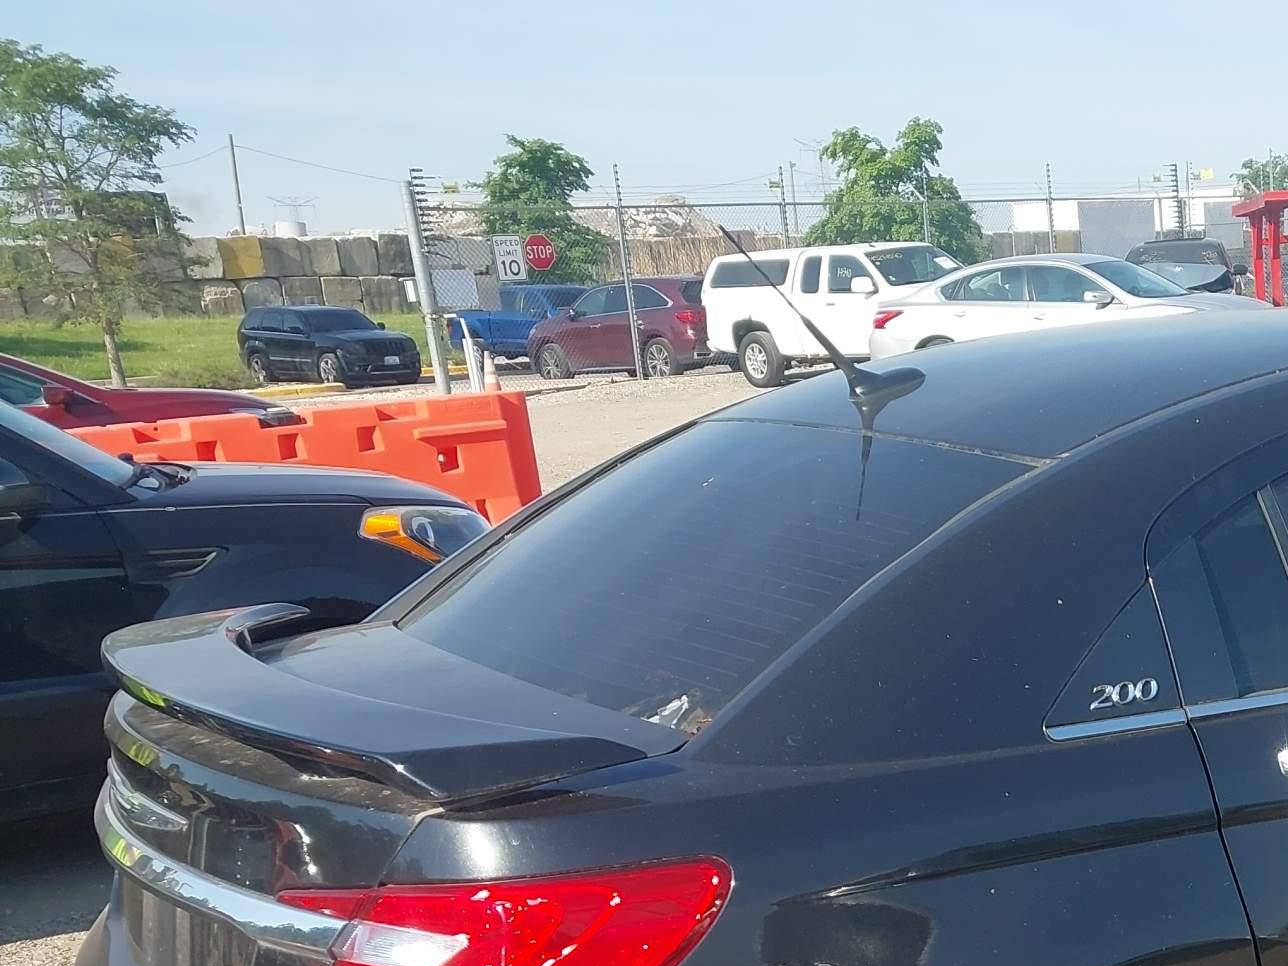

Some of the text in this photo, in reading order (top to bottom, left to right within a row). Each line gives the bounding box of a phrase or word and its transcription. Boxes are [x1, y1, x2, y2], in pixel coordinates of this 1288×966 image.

[526, 245, 552, 259] STOP
[501, 260, 521, 276] 10
[1090, 678, 1158, 710] 200
